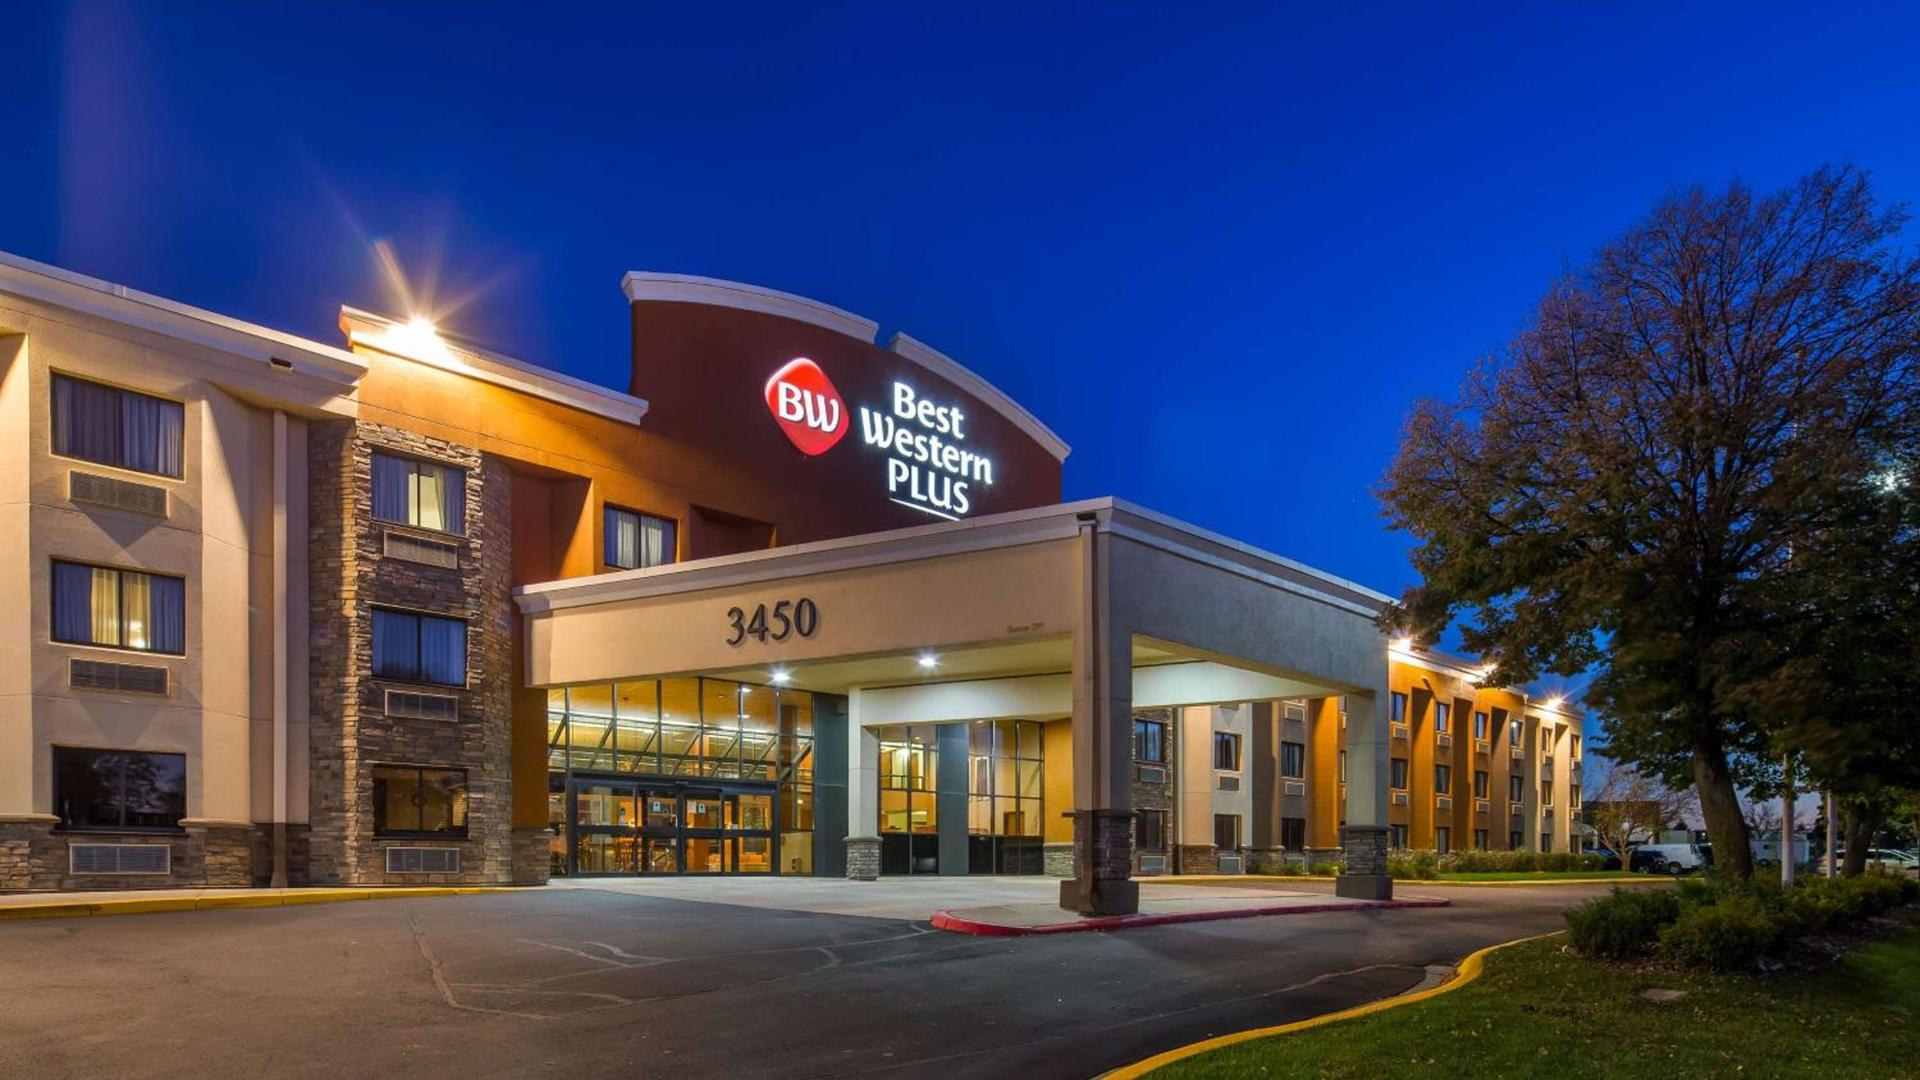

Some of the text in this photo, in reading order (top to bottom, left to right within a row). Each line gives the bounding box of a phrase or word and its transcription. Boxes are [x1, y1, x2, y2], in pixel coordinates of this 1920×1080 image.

[778, 381, 839, 432] BW
[893, 382, 965, 439] Best
[861, 407, 993, 484] Western
[888, 457, 969, 514] PLUS
[726, 597, 817, 645] 3450
